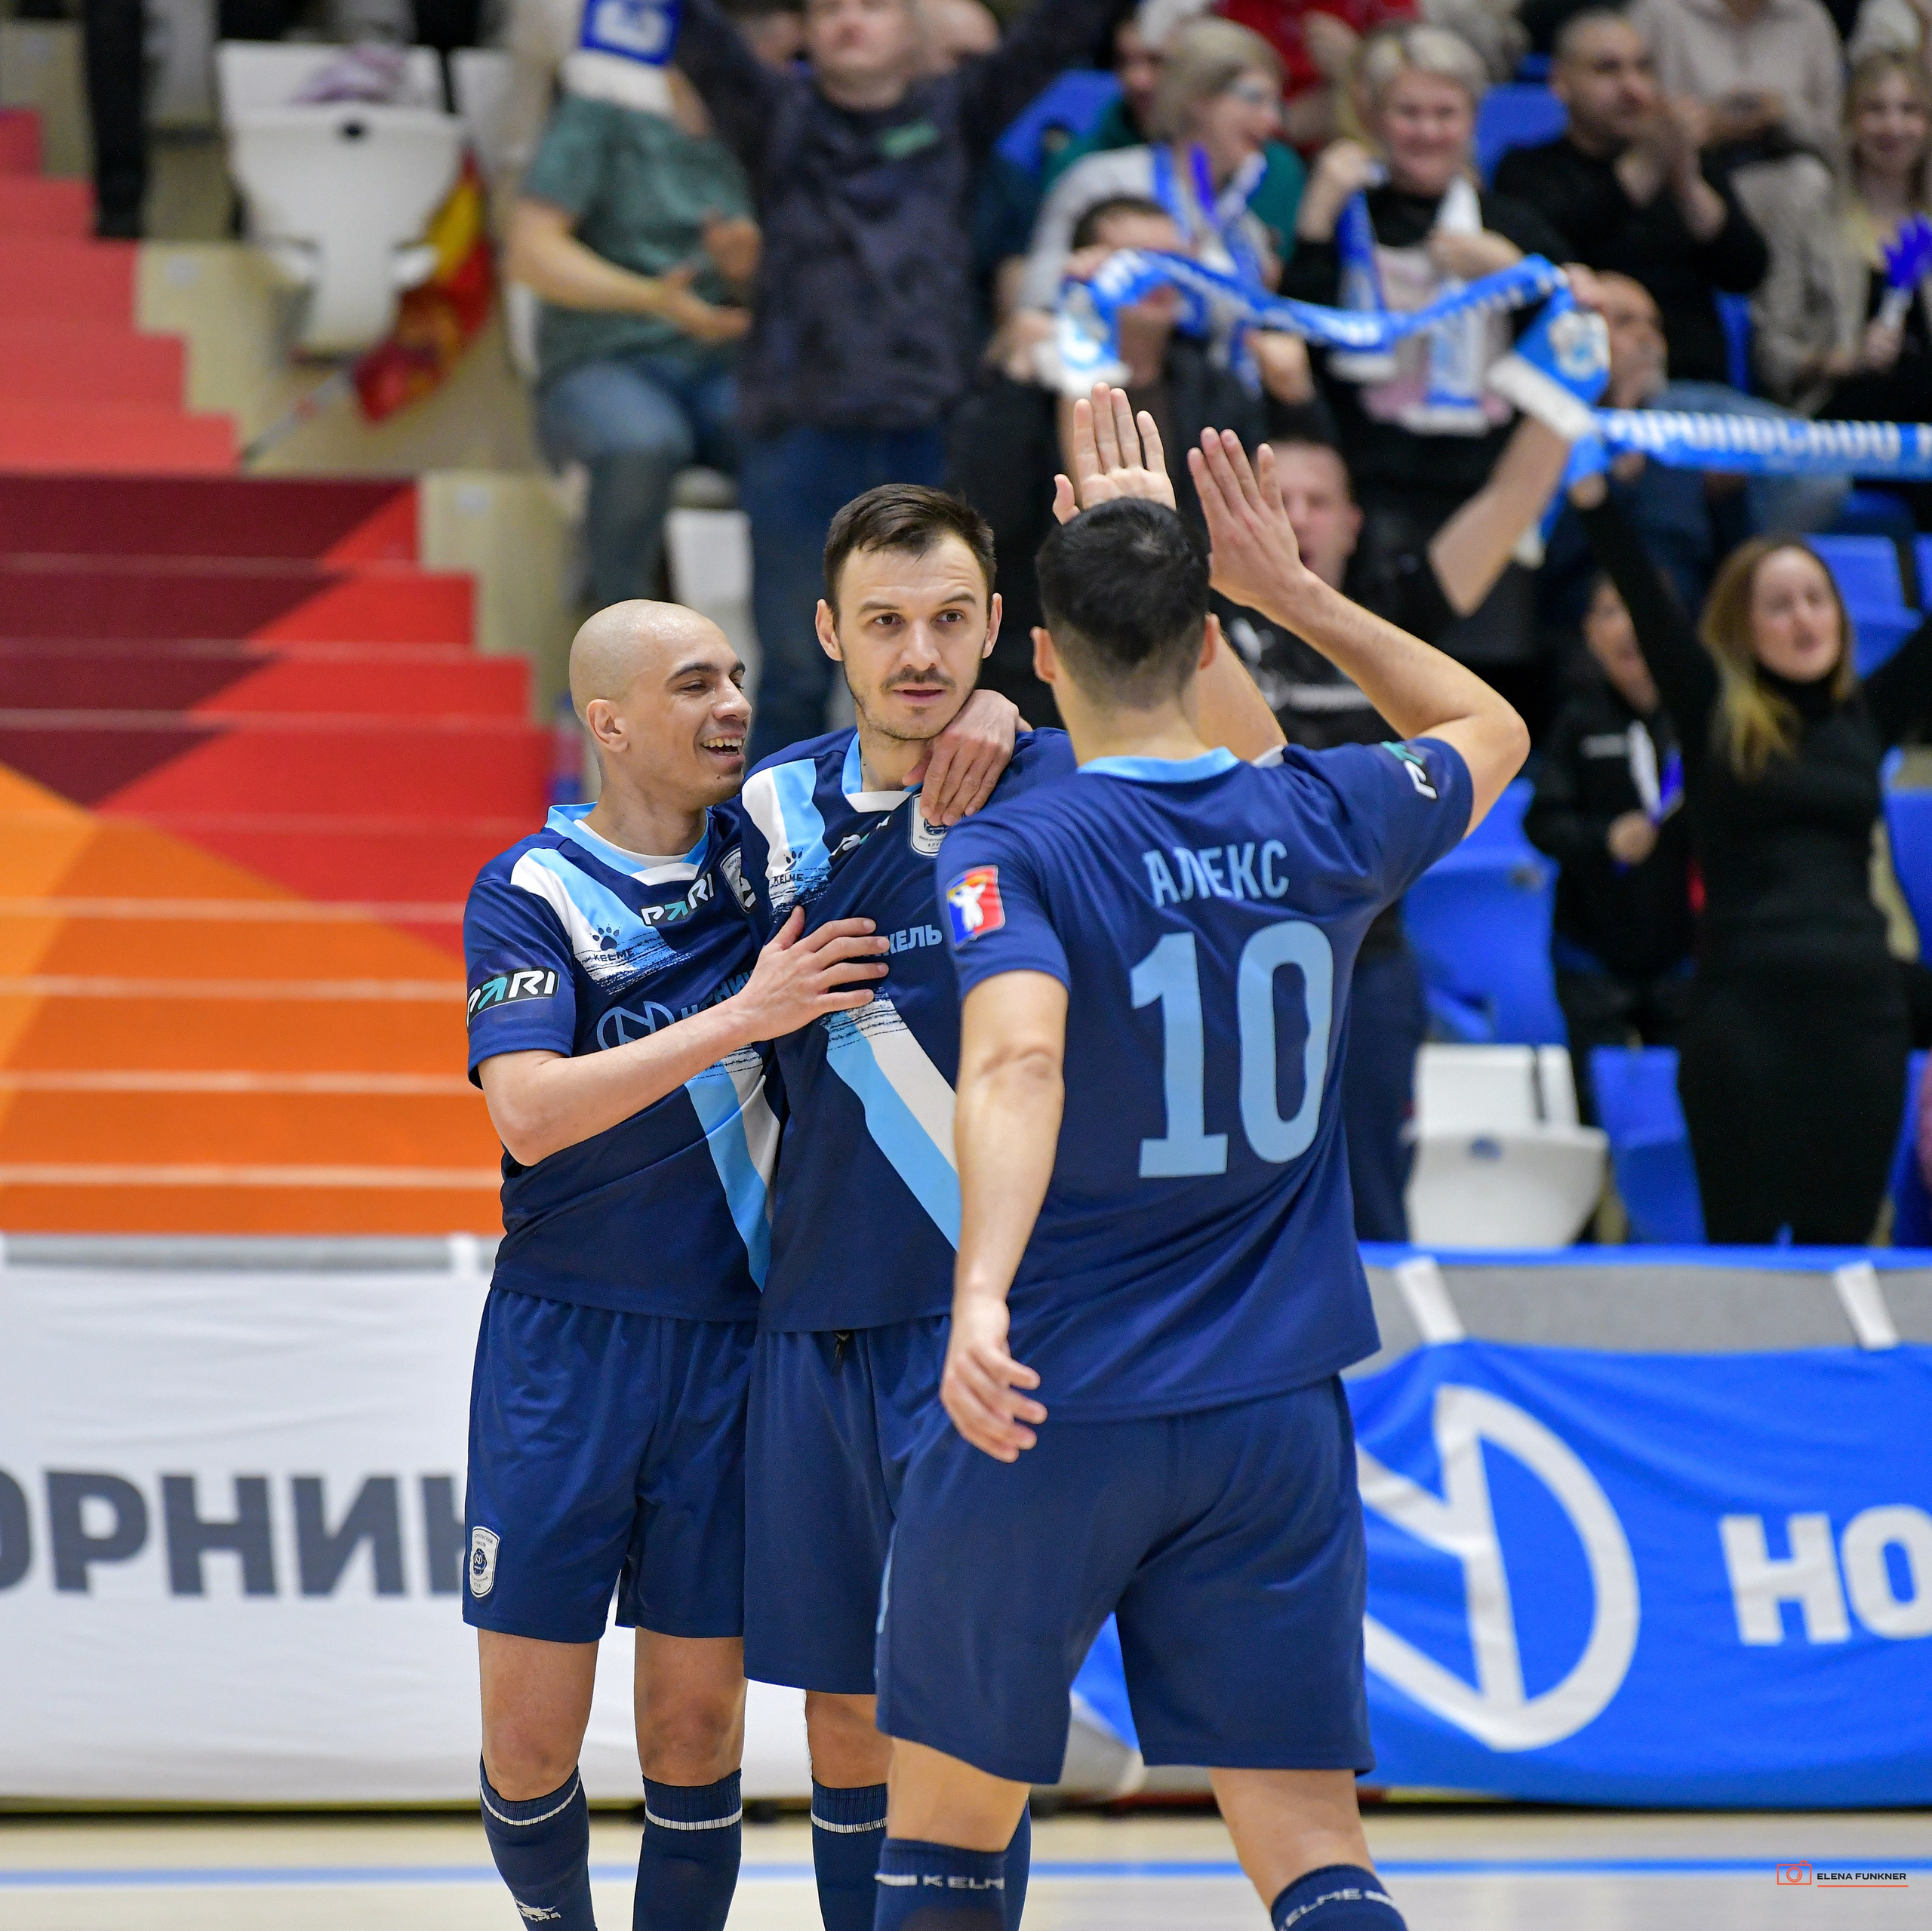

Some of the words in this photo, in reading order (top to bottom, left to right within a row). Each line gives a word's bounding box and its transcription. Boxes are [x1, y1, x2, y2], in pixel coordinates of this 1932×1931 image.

[774, 873, 804, 885] KELME
[1142, 838, 1290, 907] АЛЕКС
[641, 873, 715, 925] PARI
[593, 949, 635, 962] KELME
[1130, 920, 1334, 1179] 10
